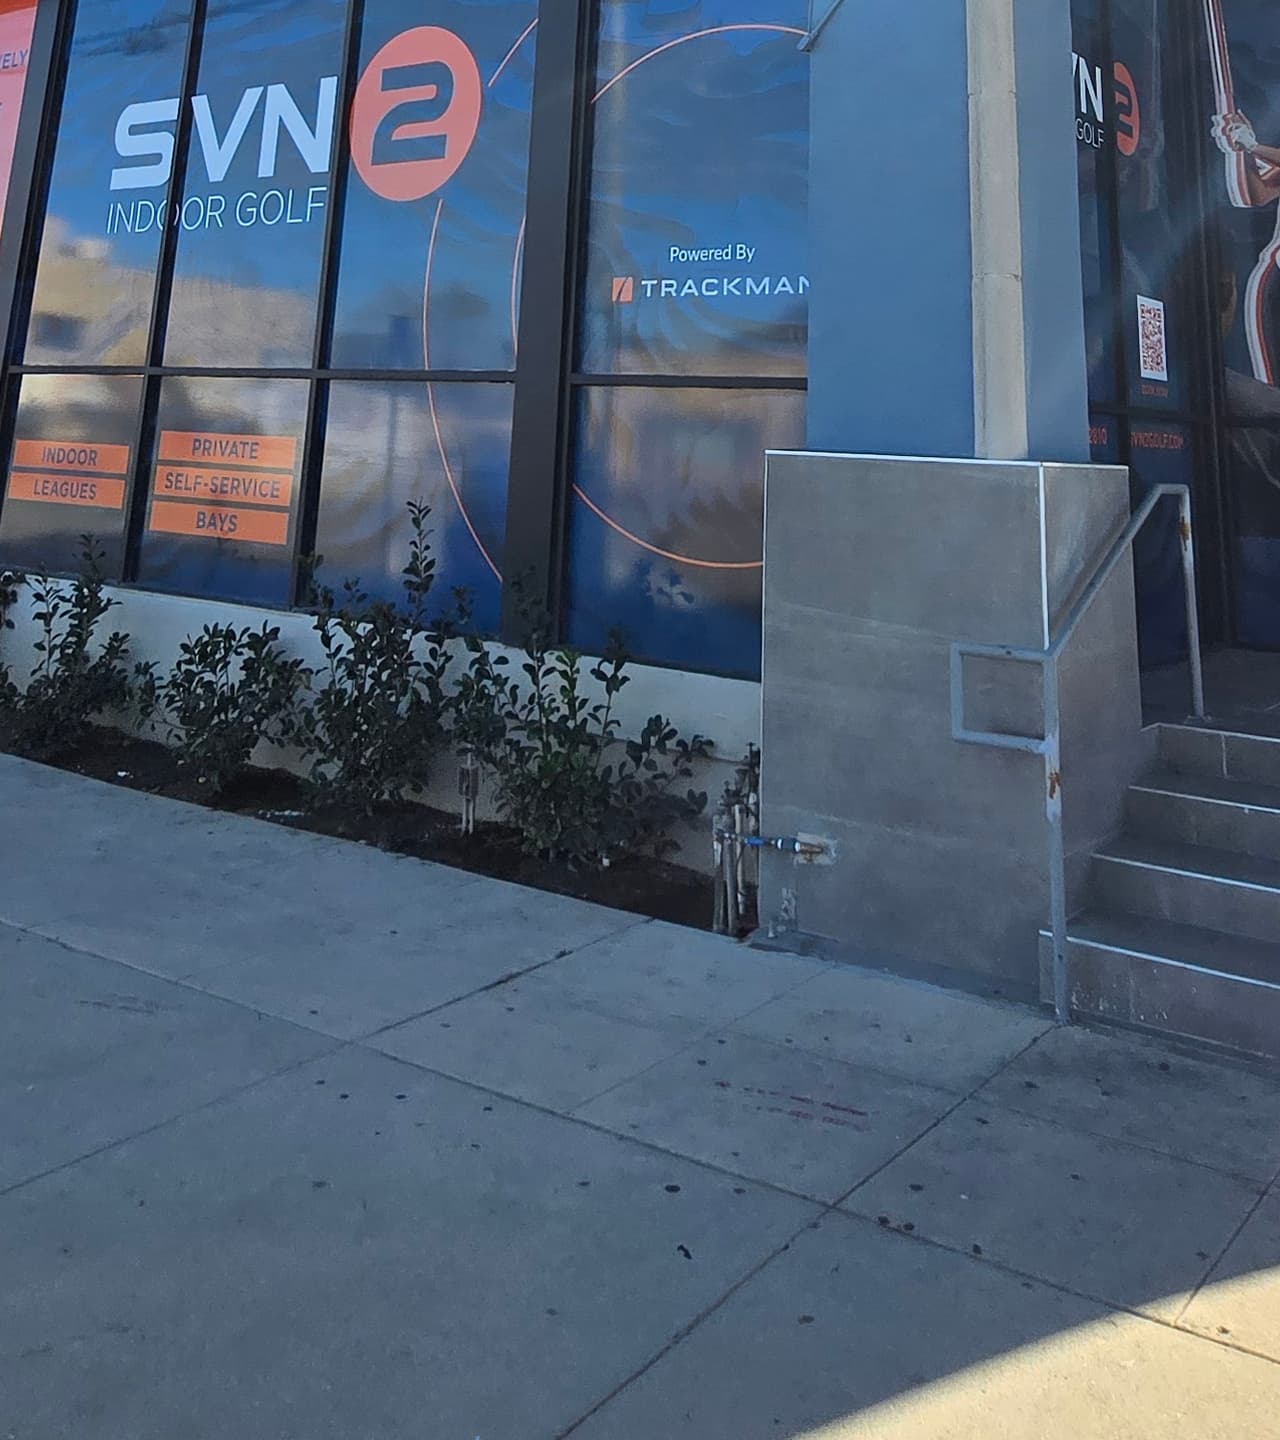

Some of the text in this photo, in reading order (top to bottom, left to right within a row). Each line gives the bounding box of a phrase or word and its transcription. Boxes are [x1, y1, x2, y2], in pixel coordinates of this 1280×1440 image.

[109, 76, 338, 190] SVN
[1075, 117, 1105, 149] GOLF
[106, 186, 328, 234] INDOOR GOLF
[669, 243, 756, 262] Powered By
[42, 446, 97, 466] INDOOR
[192, 438, 259, 459] PRIVATE
[33, 479, 97, 500] LEAGUES
[164, 471, 280, 499] SELF-SERVICE
[195, 510, 238, 533] BAYS
